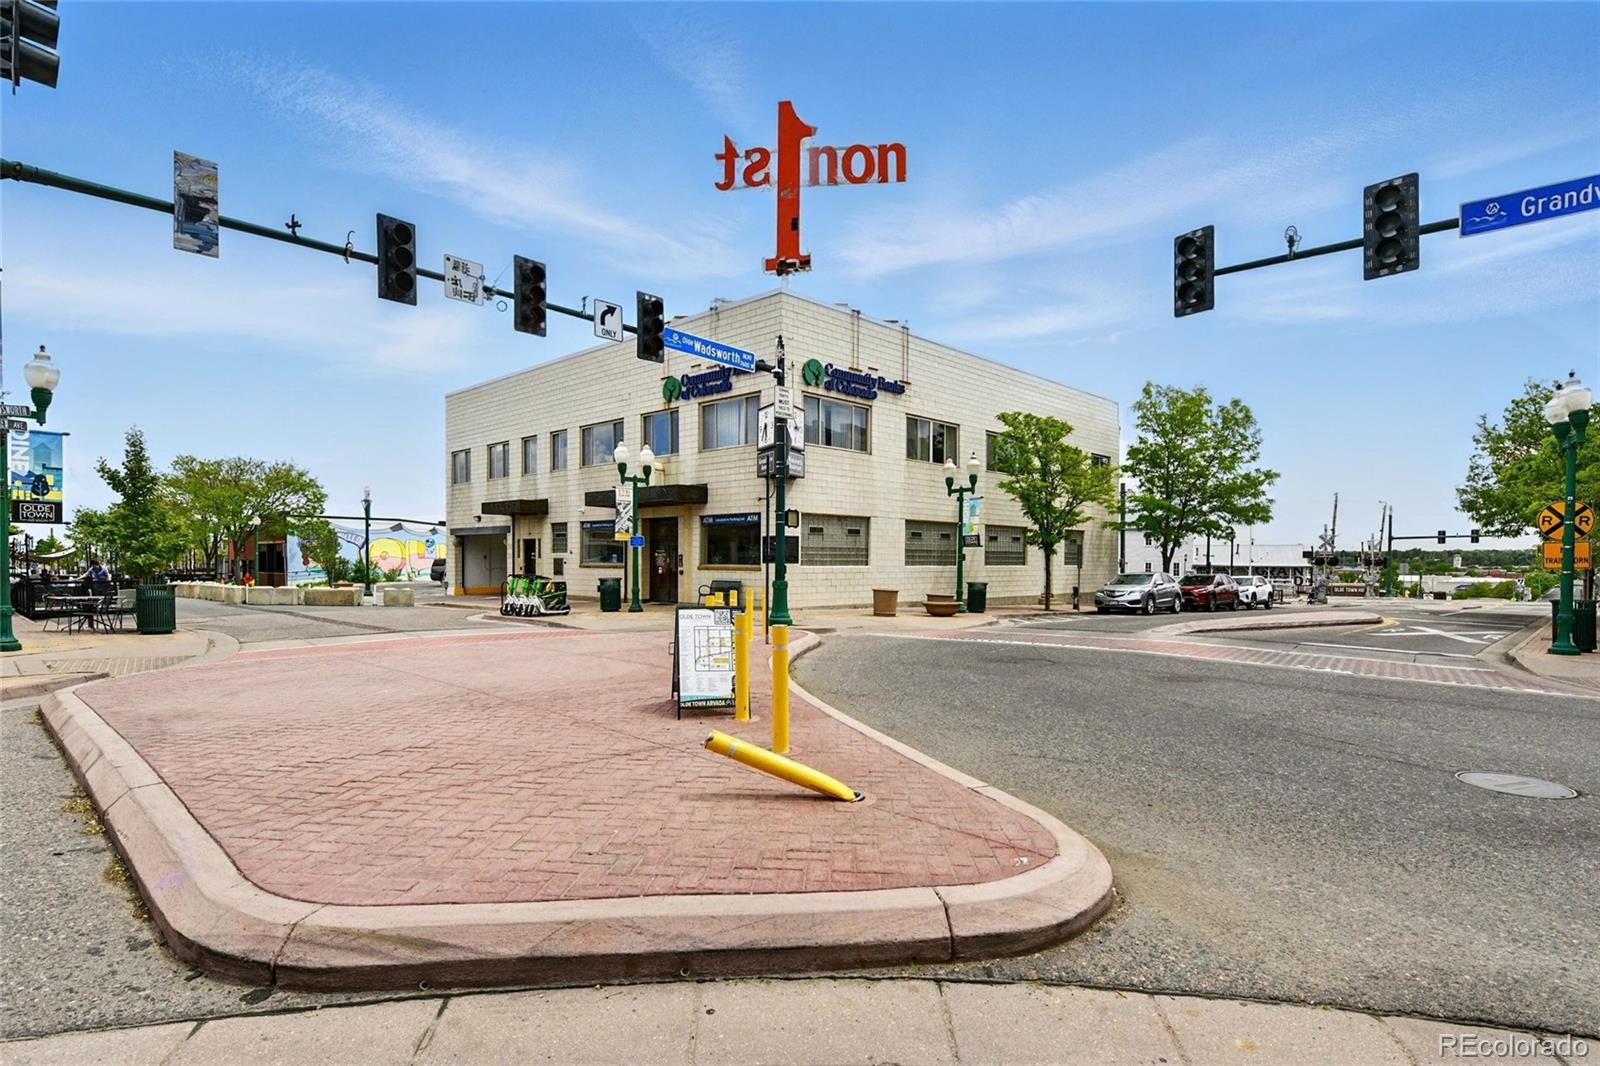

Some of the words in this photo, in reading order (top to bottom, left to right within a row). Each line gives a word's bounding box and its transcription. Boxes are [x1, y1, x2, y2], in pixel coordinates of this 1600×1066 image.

[601, 328, 617, 339] ONLY
[682, 336, 694, 346] Olde
[694, 340, 741, 364] Wadsworth
[824, 363, 878, 390] Community
[681, 386, 691, 400] of
[690, 382, 733, 398] Colorado
[824, 379, 836, 391] of
[835, 380, 878, 400] Colorado
[0, 405, 28, 416] SWORTH
[13, 421, 24, 429] AVE
[1542, 515, 1553, 526] R
[1578, 515, 1591, 527] R
